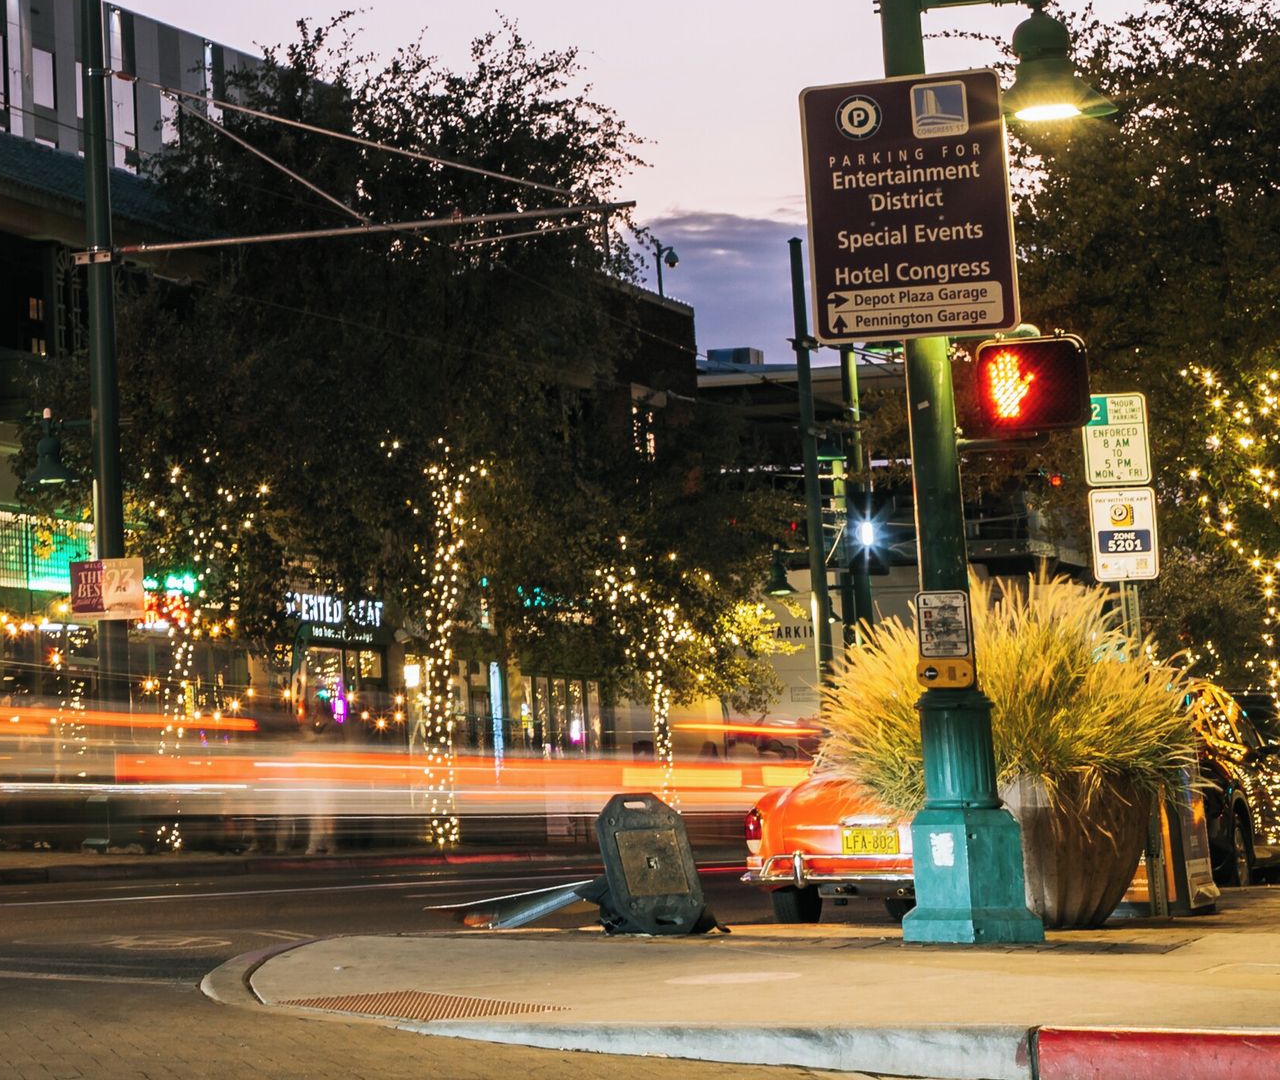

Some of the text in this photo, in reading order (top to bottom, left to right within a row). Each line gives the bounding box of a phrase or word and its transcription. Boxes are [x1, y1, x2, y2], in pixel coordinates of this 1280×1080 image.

[852, 110, 865, 126] P
[916, 126, 953, 136] CONGRESS
[829, 143, 981, 168] PARKING FOR
[832, 160, 980, 190] Entertainment
[871, 188, 944, 212] District
[837, 222, 984, 253] Special Events
[835, 260, 991, 286] Hotel Congress
[854, 287, 988, 308] Depot Plaza Garage
[855, 309, 987, 328] Pennington Garage
[1091, 404, 1101, 420] 2
[1093, 428, 1138, 438] ENFORCED
[1103, 438, 1130, 448] 8 AM
[1112, 449, 1122, 457] TO
[1105, 458, 1132, 469] 5 PM
[1095, 469, 1142, 478] MON FRI
[1113, 532, 1135, 540] ZONE
[1108, 539, 1143, 552] 5201
[846, 835, 894, 849] LFA-802
